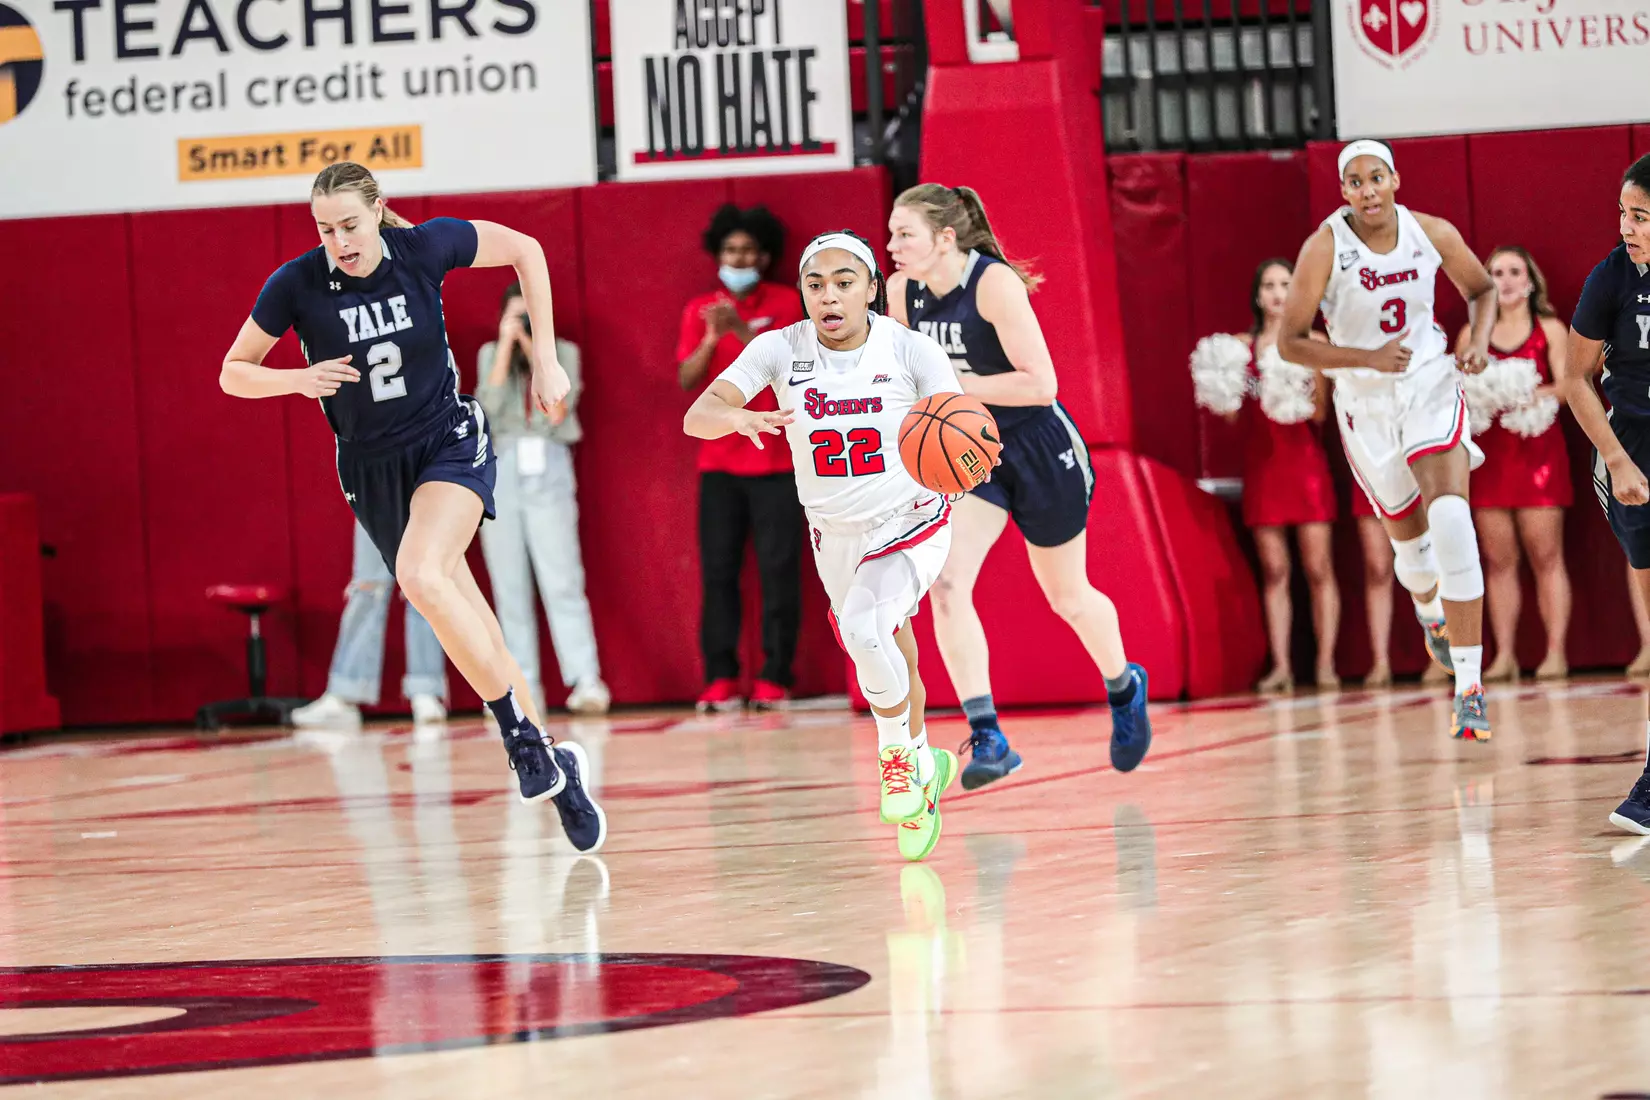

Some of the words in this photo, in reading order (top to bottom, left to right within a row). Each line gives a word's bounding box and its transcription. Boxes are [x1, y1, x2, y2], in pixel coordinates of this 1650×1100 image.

[54, 0, 537, 61] TEACHERS
[64, 69, 228, 119] federal
[246, 60, 386, 108] credit
[403, 55, 537, 98] union
[645, 54, 704, 159] NO
[716, 48, 822, 155] HATE
[188, 142, 286, 173] Smart
[298, 137, 357, 165] For
[367, 133, 413, 162] All
[339, 295, 413, 343] YALE
[1380, 297, 1406, 334] 3
[366, 341, 407, 402] 2
[808, 427, 886, 477] 22
